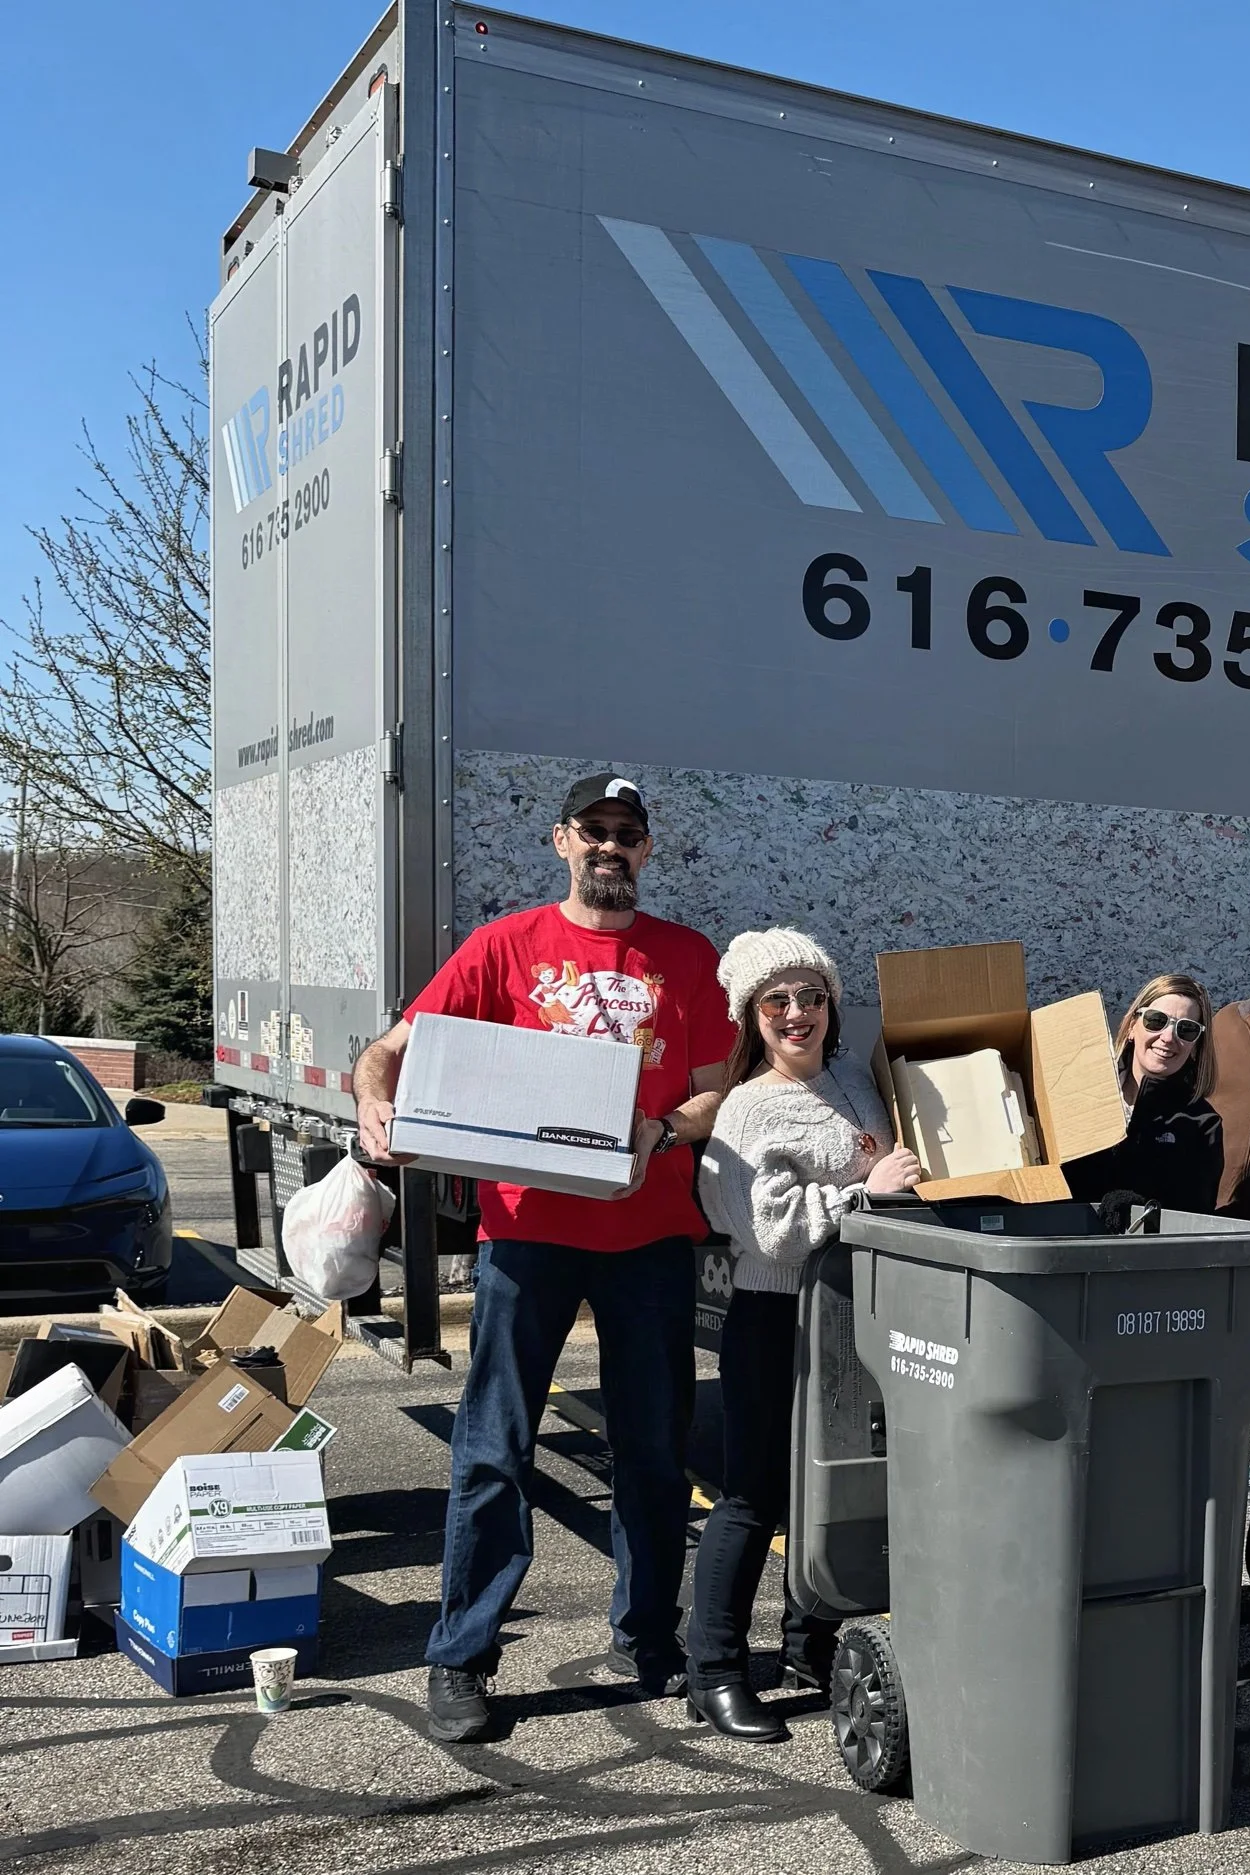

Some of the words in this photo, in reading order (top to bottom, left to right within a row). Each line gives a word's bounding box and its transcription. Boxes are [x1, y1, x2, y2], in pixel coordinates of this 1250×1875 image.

[276, 292, 361, 425] RAPID
[277, 383, 345, 477] SHRED
[294, 467, 330, 532] 2900
[606, 976, 627, 993] The
[541, 1131, 591, 1145] BANKERS
[591, 1138, 614, 1148] BOX
[890, 1329, 926, 1357] RAPID
[925, 1340, 959, 1366] SHRED
[890, 1355, 955, 1390] 616-735-2900
[212, 1501, 229, 1517] X9
